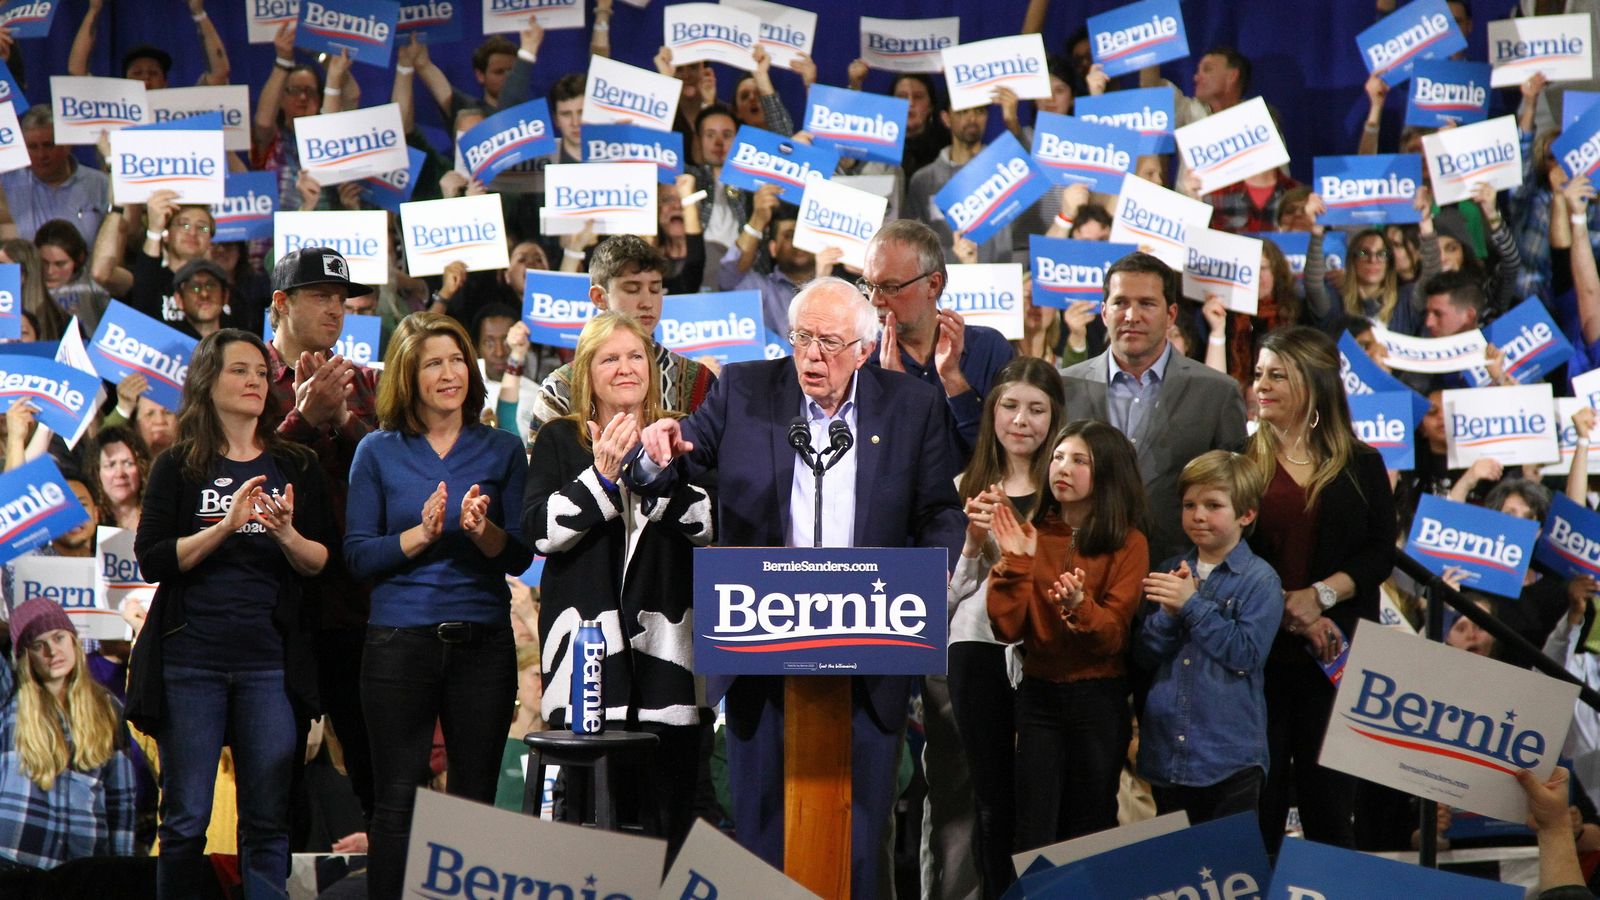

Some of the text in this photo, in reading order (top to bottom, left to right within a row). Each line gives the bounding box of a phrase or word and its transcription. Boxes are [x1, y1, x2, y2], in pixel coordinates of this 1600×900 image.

[255, 0, 299, 17] Ber
[304, 1, 390, 42] Bernie
[400, 0, 453, 23] rnie
[672, 22, 753, 48] Bernie
[868, 32, 950, 53] Bernie
[1096, 15, 1177, 53] Bernie
[1367, 12, 1449, 68] Bernie
[1496, 33, 1583, 59] Bernie
[953, 54, 1040, 84] Bernie
[592, 77, 669, 119] Bernie
[1415, 77, 1485, 107] Bernie
[60, 96, 142, 121] Bernie
[809, 104, 899, 143] Bernie
[305, 127, 398, 160] Bernie
[466, 118, 545, 170] Bernie
[588, 139, 678, 167] Bernie
[1038, 132, 1131, 172] Bernie
[1189, 123, 1271, 168] Bernie
[1436, 139, 1515, 177] Bernie
[120, 151, 215, 175] Bernie
[555, 184, 648, 208] Bernie
[948, 157, 1030, 226] Bernie
[1320, 173, 1415, 199] Bernie
[413, 218, 496, 247] Bernie
[805, 199, 873, 240] Bernie
[1187, 247, 1252, 284] Bernie
[938, 286, 1014, 311] ernie
[660, 313, 756, 344] Bernie
[1452, 409, 1546, 438] Bernie
[1416, 517, 1522, 568] Bernie
[1550, 516, 1600, 567] Ber
[763, 561, 878, 572] BernieSanders.com
[24, 581, 96, 608] Bern
[714, 577, 927, 636] Bernie
[583, 641, 605, 733] Bernie
[1351, 668, 1546, 769] Bernie
